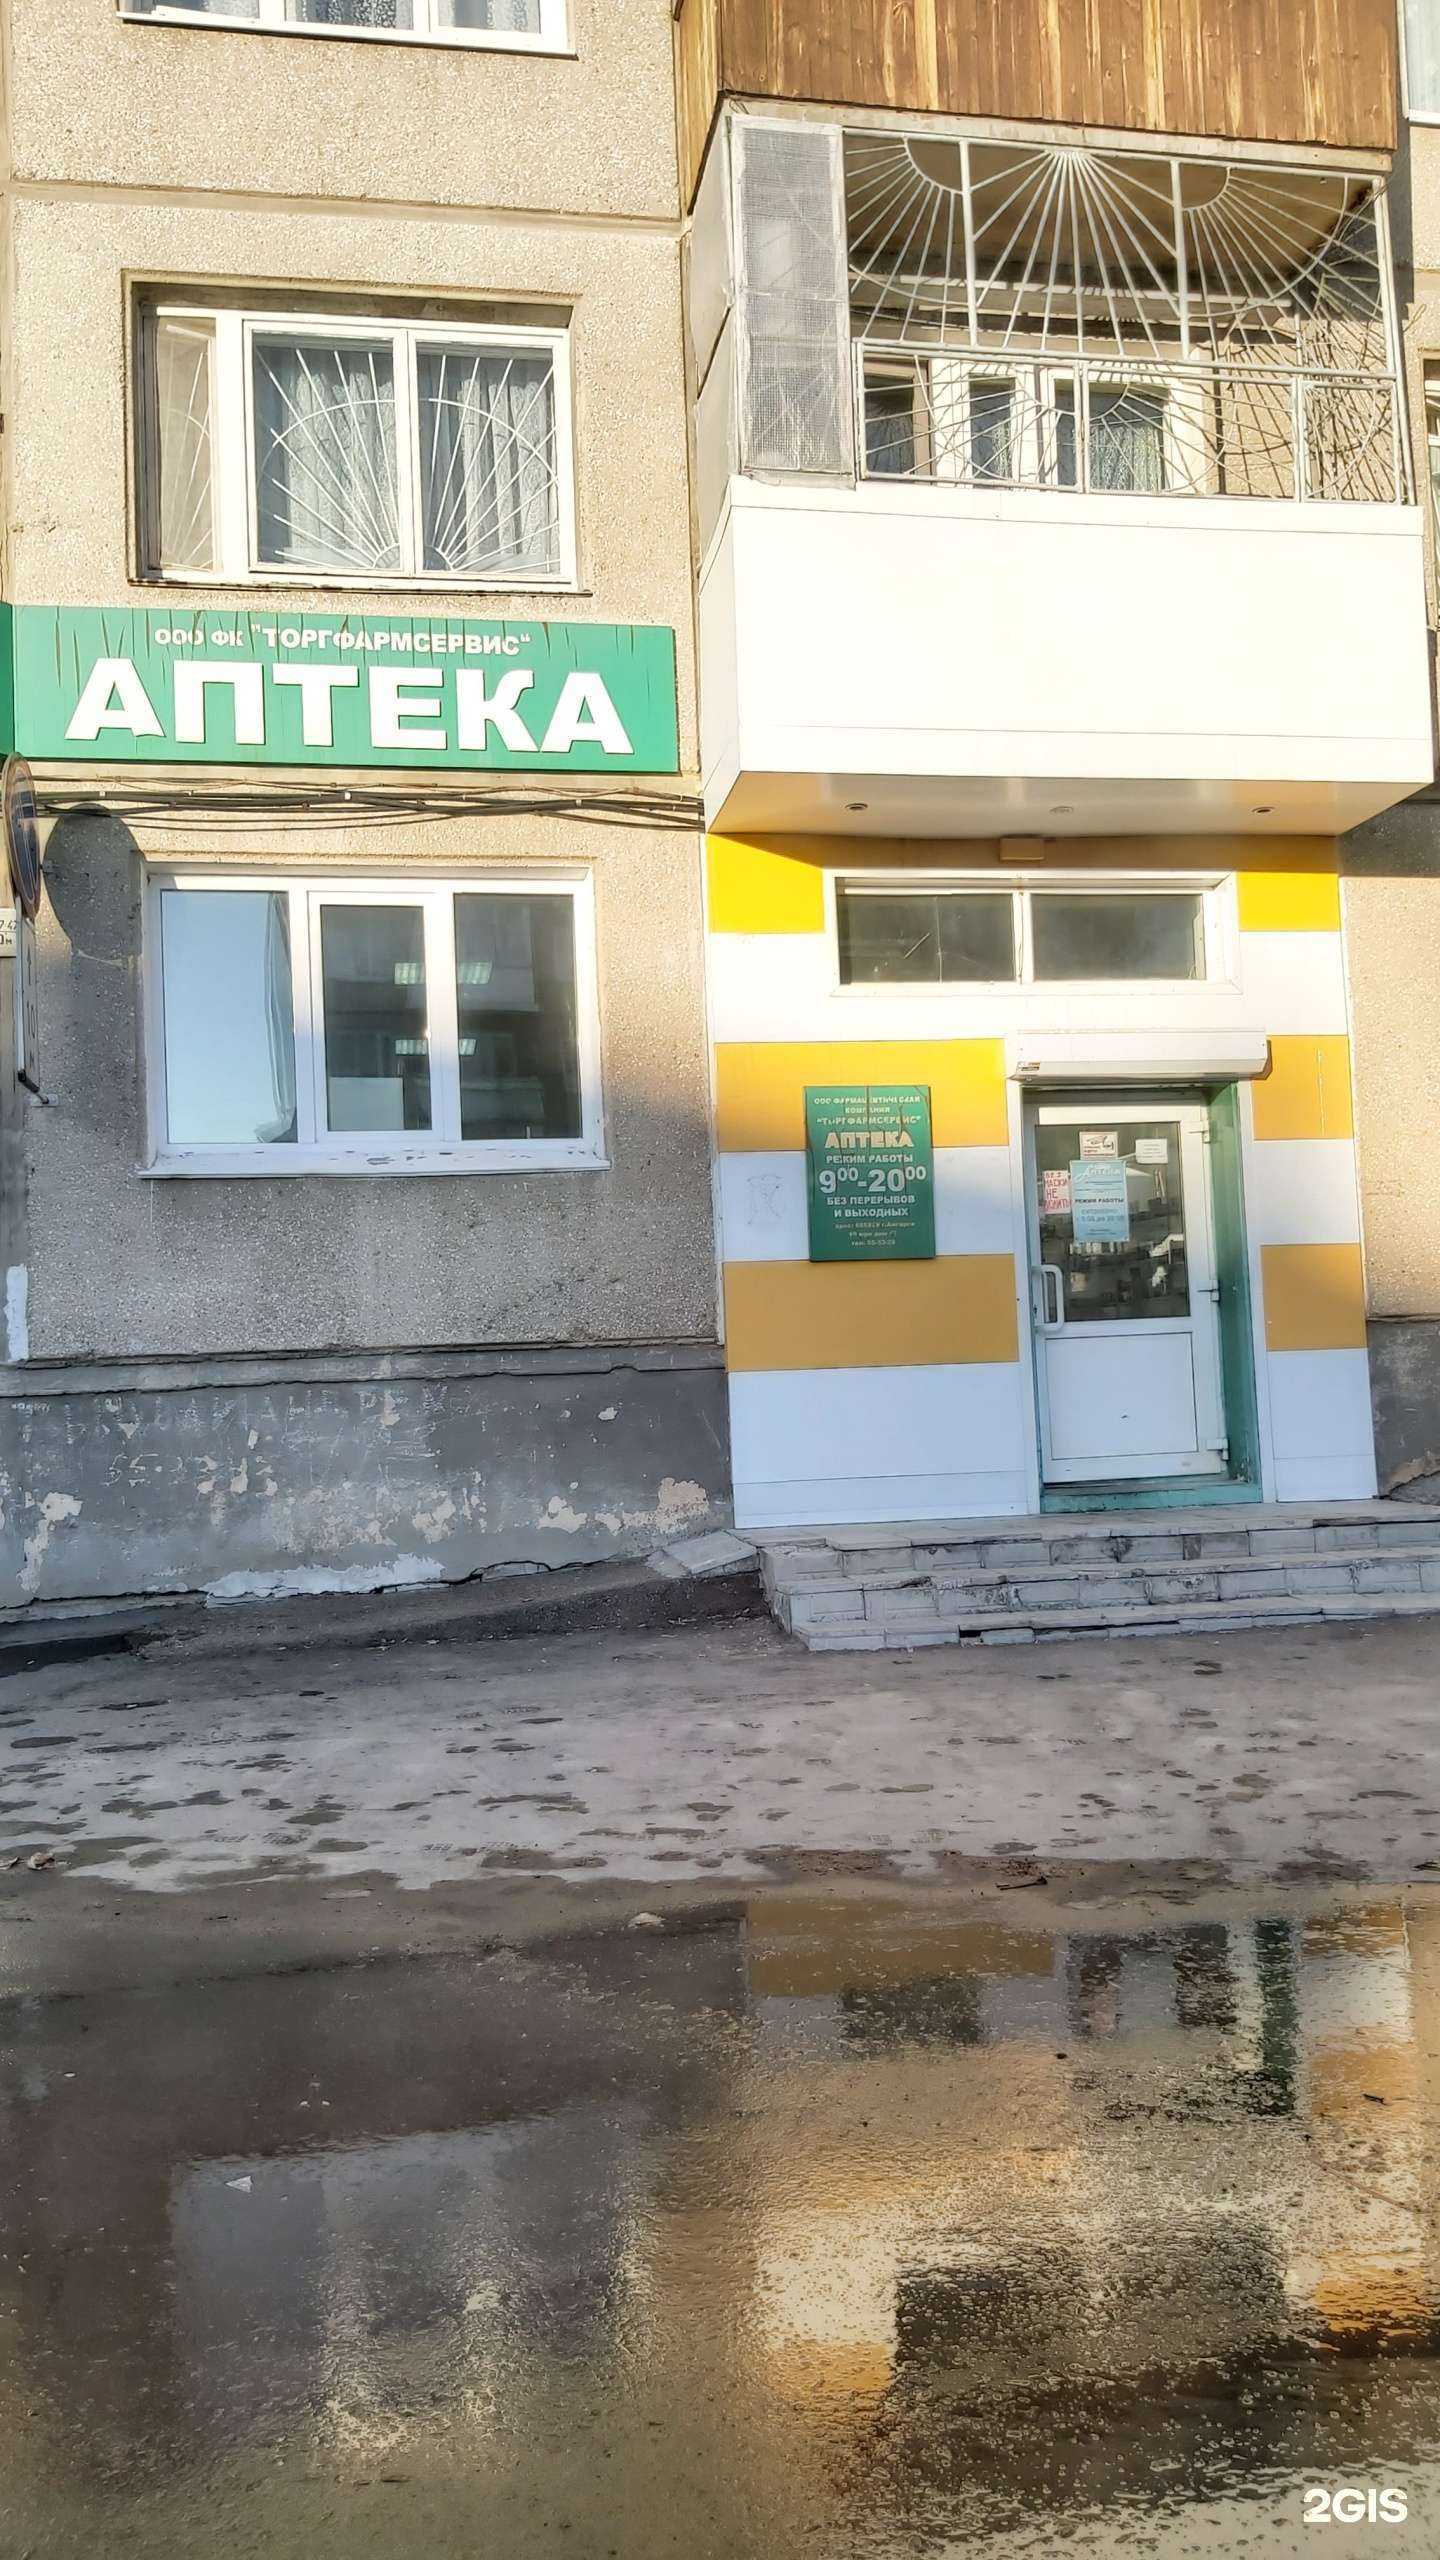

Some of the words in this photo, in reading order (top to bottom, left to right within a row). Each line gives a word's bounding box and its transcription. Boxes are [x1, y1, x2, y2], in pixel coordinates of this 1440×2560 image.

[154, 628, 203, 645] ООО
[211, 630, 243, 647] ФК
[64, 657, 635, 755] АПТЕКА
[814, 1097, 831, 1105] ООО
[825, 1130, 914, 1148] АПТЕКА
[826, 1155, 865, 1164] РЕЖИМ
[869, 1153, 913, 1163] РАБОТЫ
[1046, 1188, 1058, 1199] НЕ
[827, 1196, 847, 1205] БЕЗ
[850, 1195, 915, 1204] ПЕРЕРЫВОВ
[834, 1209, 841, 1217] И
[845, 1207, 909, 1217] ВЫХОДНЫХ
